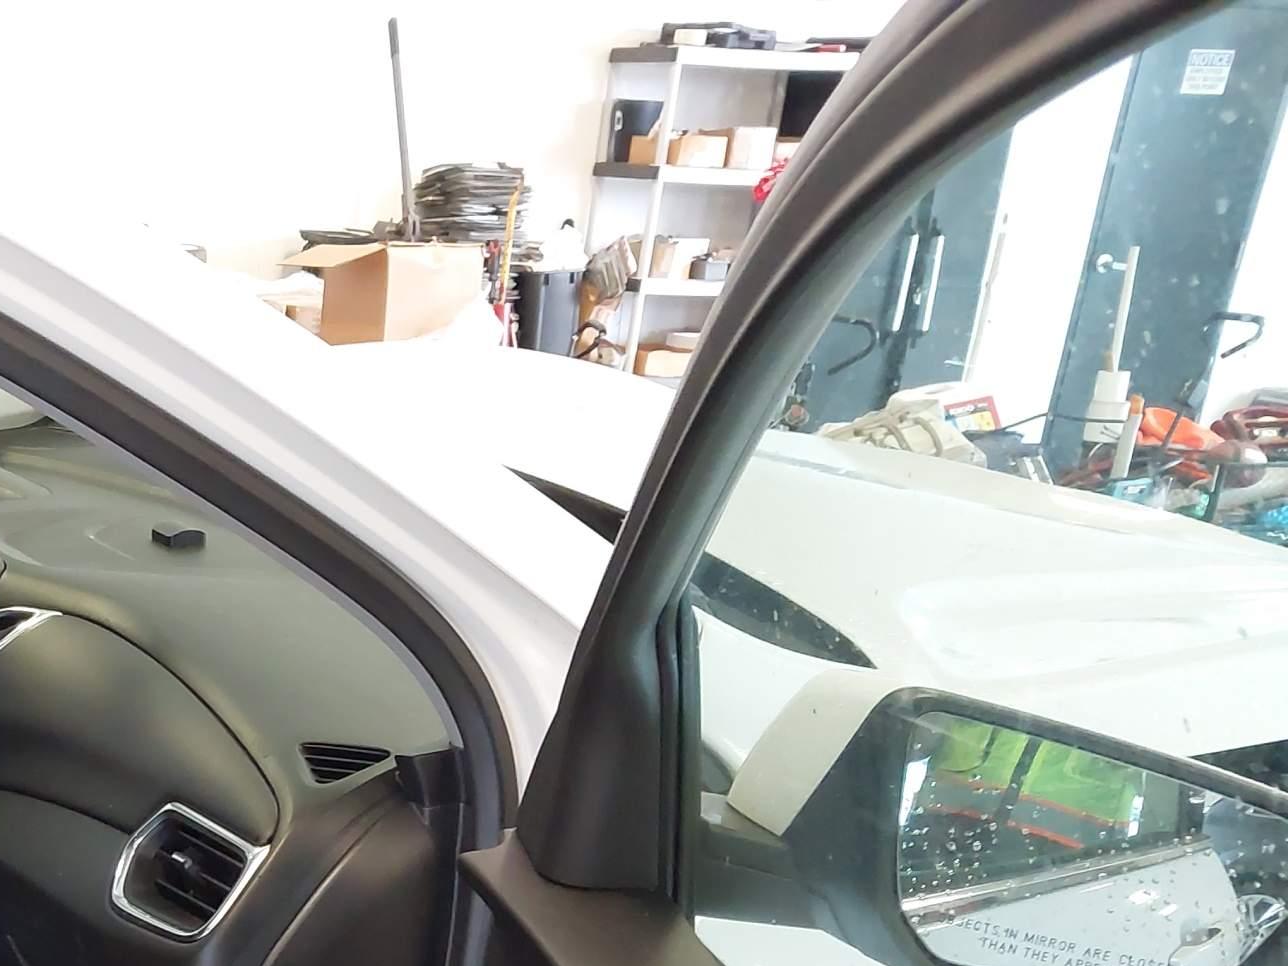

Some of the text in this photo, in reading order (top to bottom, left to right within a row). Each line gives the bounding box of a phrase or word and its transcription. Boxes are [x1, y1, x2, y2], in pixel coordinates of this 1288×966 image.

[1190, 53, 1231, 66] NOTICE
[979, 937, 1018, 955] THAN
[1024, 946, 1060, 964] THEY
[1023, 932, 1076, 954] MIRROR
[1082, 947, 1112, 962] ARE
